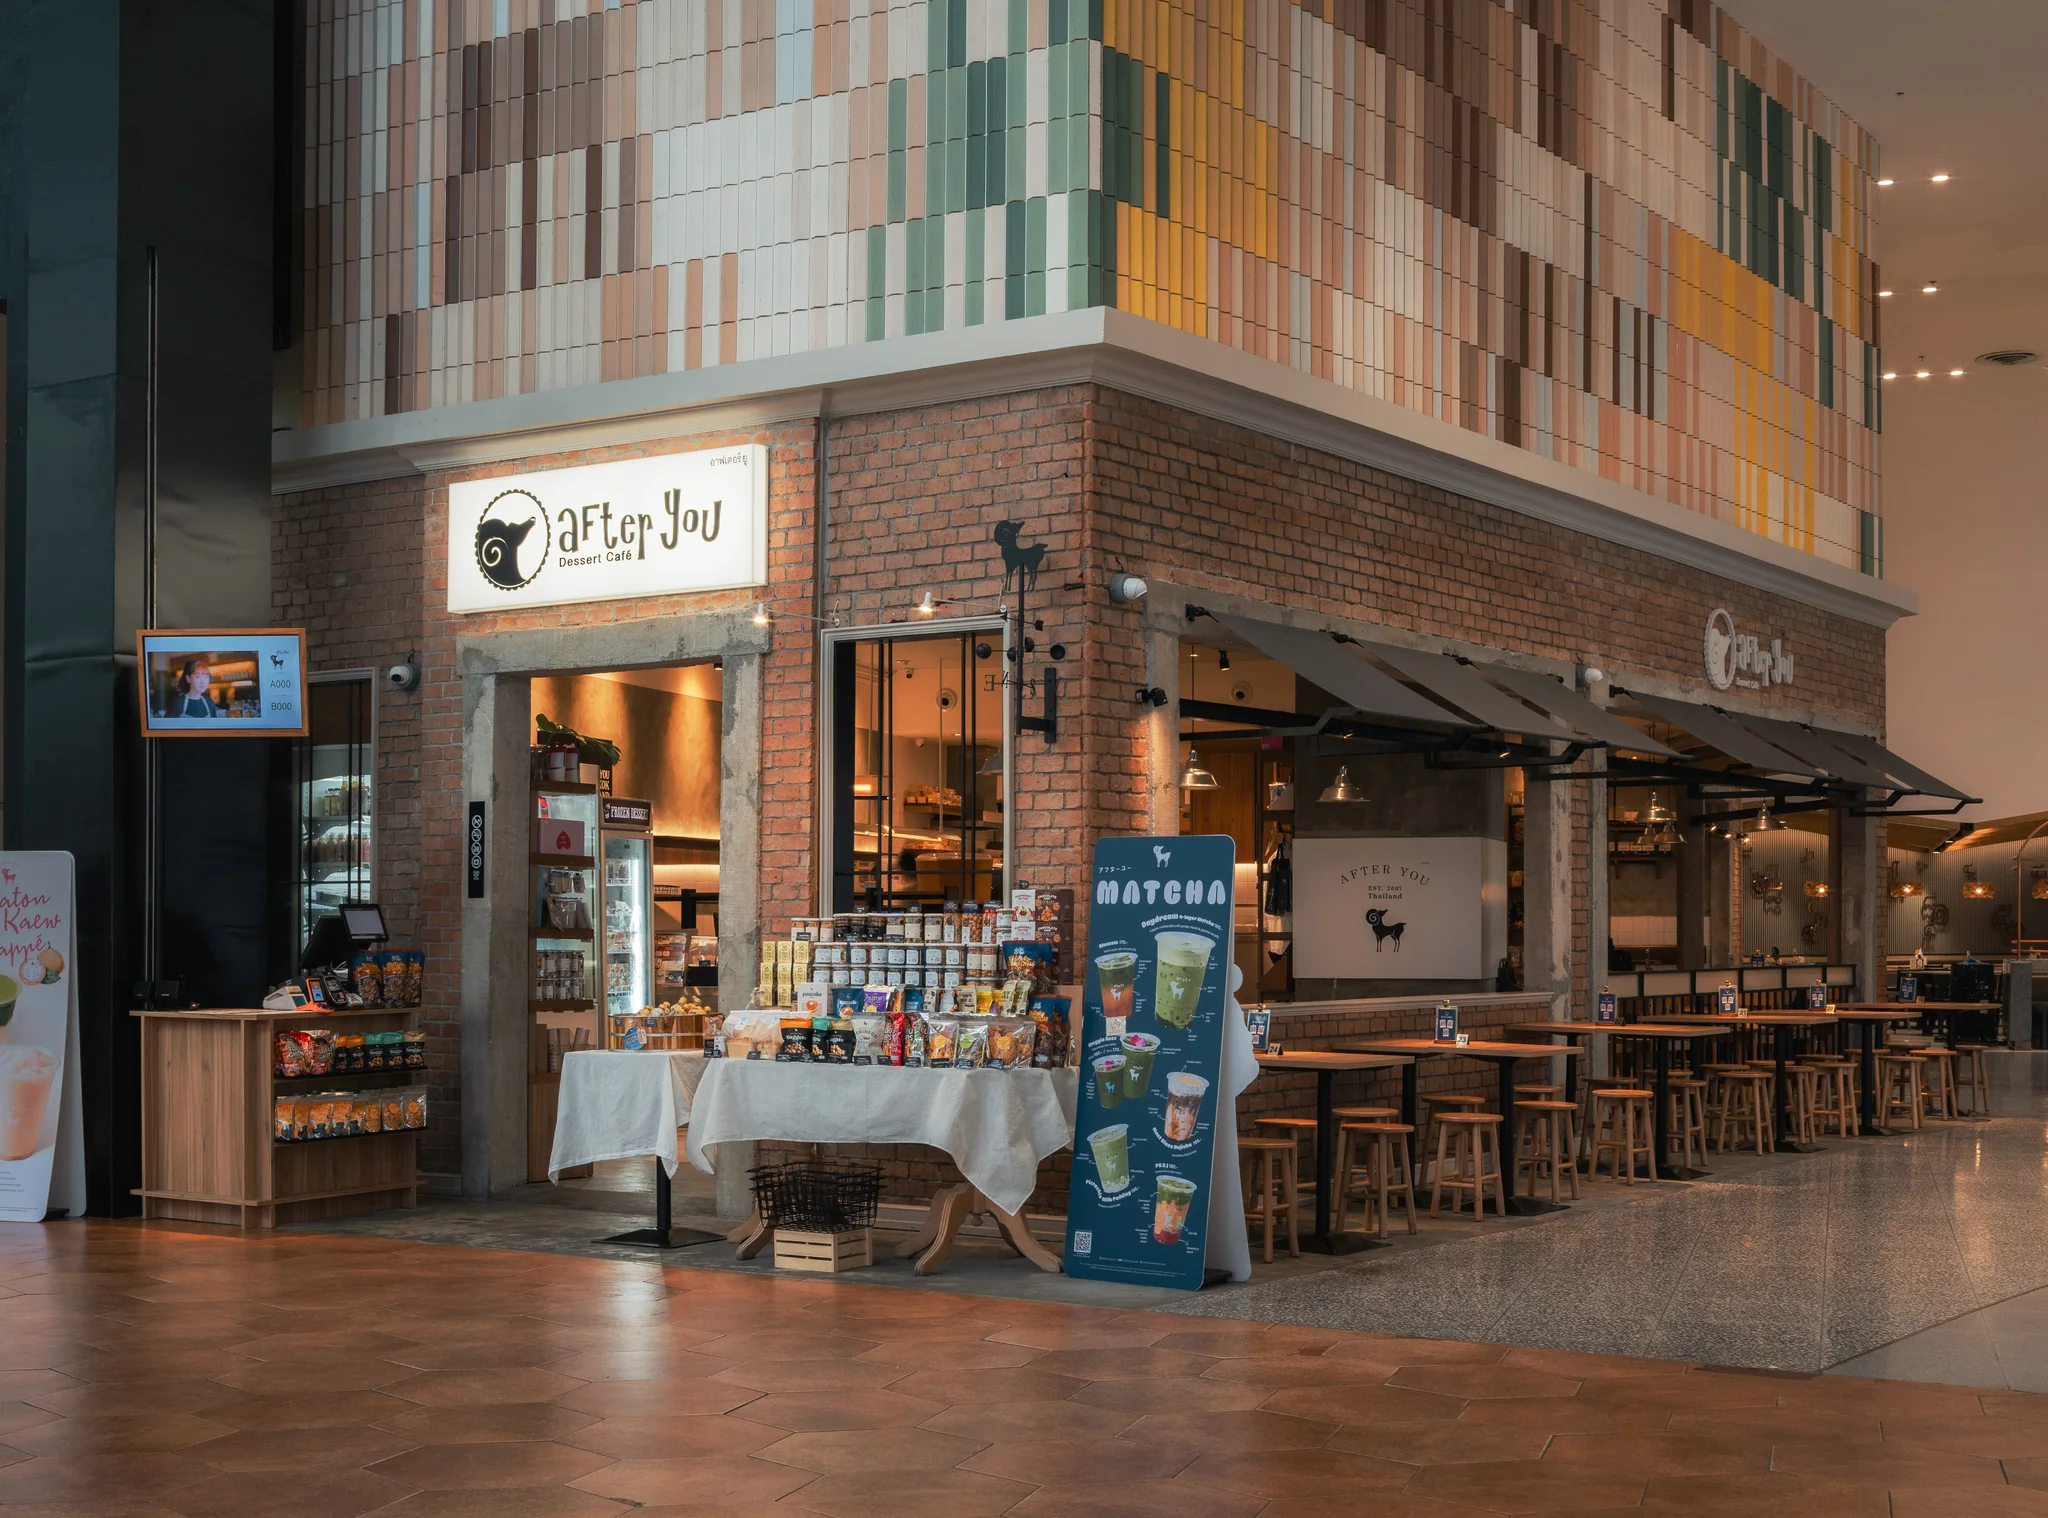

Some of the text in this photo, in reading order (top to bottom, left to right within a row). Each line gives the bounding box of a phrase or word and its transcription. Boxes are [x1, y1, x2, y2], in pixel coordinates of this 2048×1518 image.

[559, 549, 632, 568] Dessert Café
[270, 679, 292, 689] A000
[271, 702, 293, 711] B000
[610, 805, 649, 820] FROZEN DESSERT
[1340, 864, 1431, 886] AFTER YOU
[1096, 879, 1226, 905] MATCHA
[1367, 892, 1403, 900] Thailand
[4, 907, 61, 935] Kaew
[1141, 913, 1179, 929] Daydream
